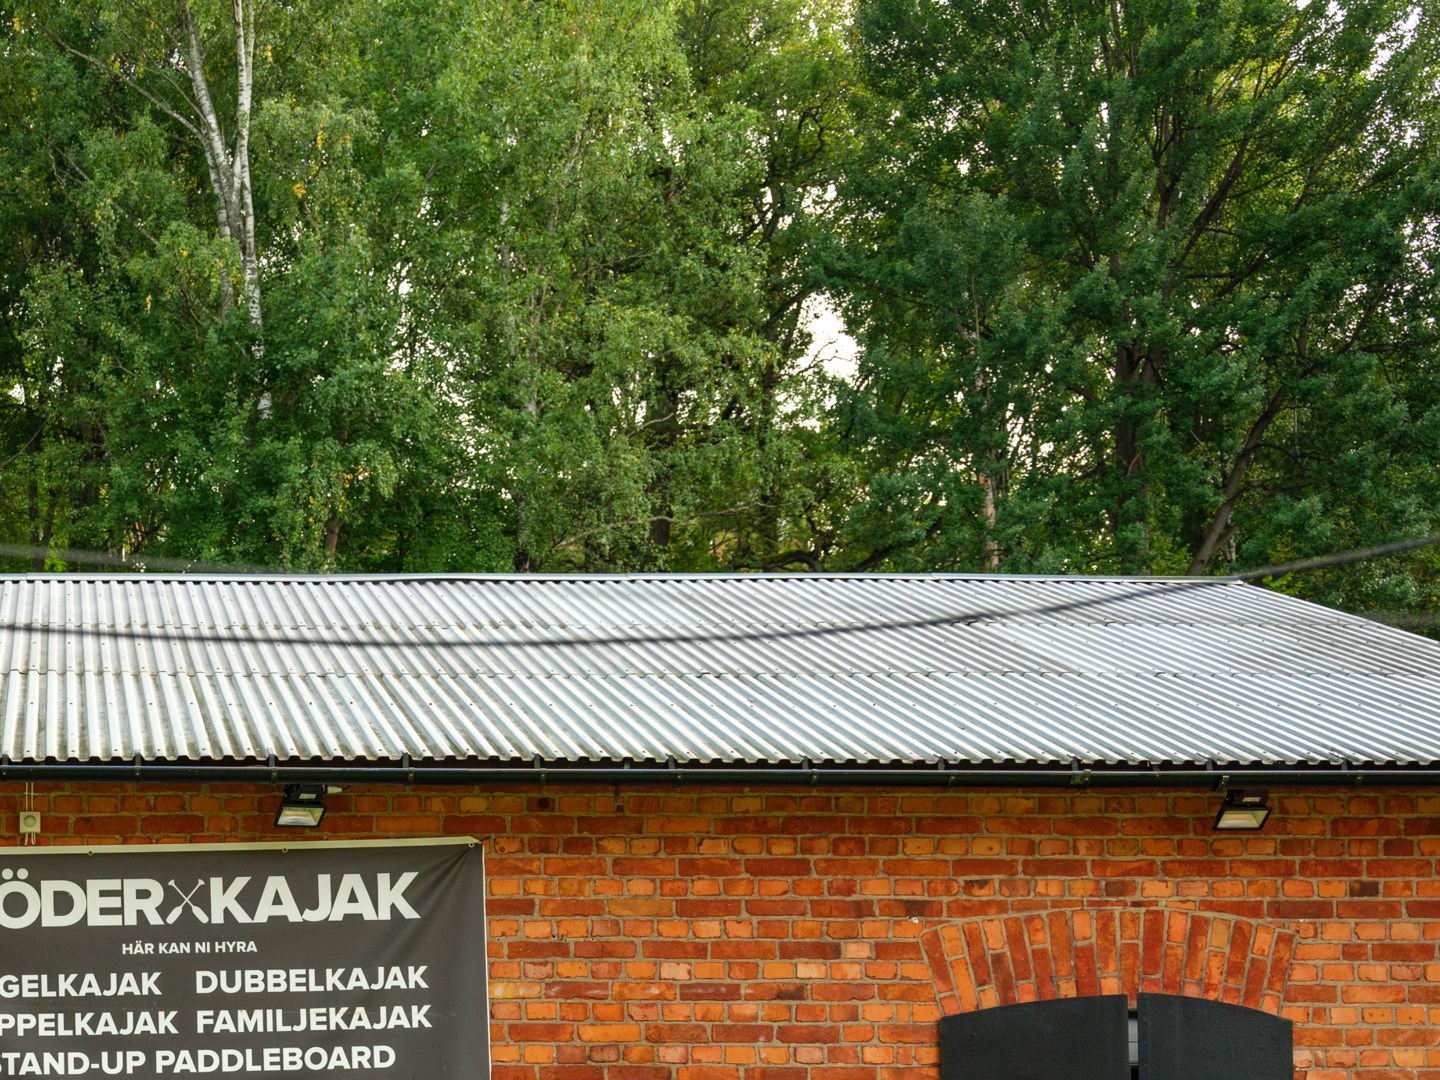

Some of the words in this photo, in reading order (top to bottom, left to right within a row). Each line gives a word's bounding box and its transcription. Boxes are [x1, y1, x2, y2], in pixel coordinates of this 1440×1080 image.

[211, 872, 420, 924] KAJAK
[122, 940, 154, 954] HÄR
[159, 942, 190, 954] KAN
[195, 942, 210, 953] NI
[215, 941, 257, 952] HYRA
[196, 966, 429, 993] DUBBELKAJAK
[197, 1005, 432, 1033] FAMILJEKAJAK
[156, 1045, 395, 1073] PADDLEBOARD
